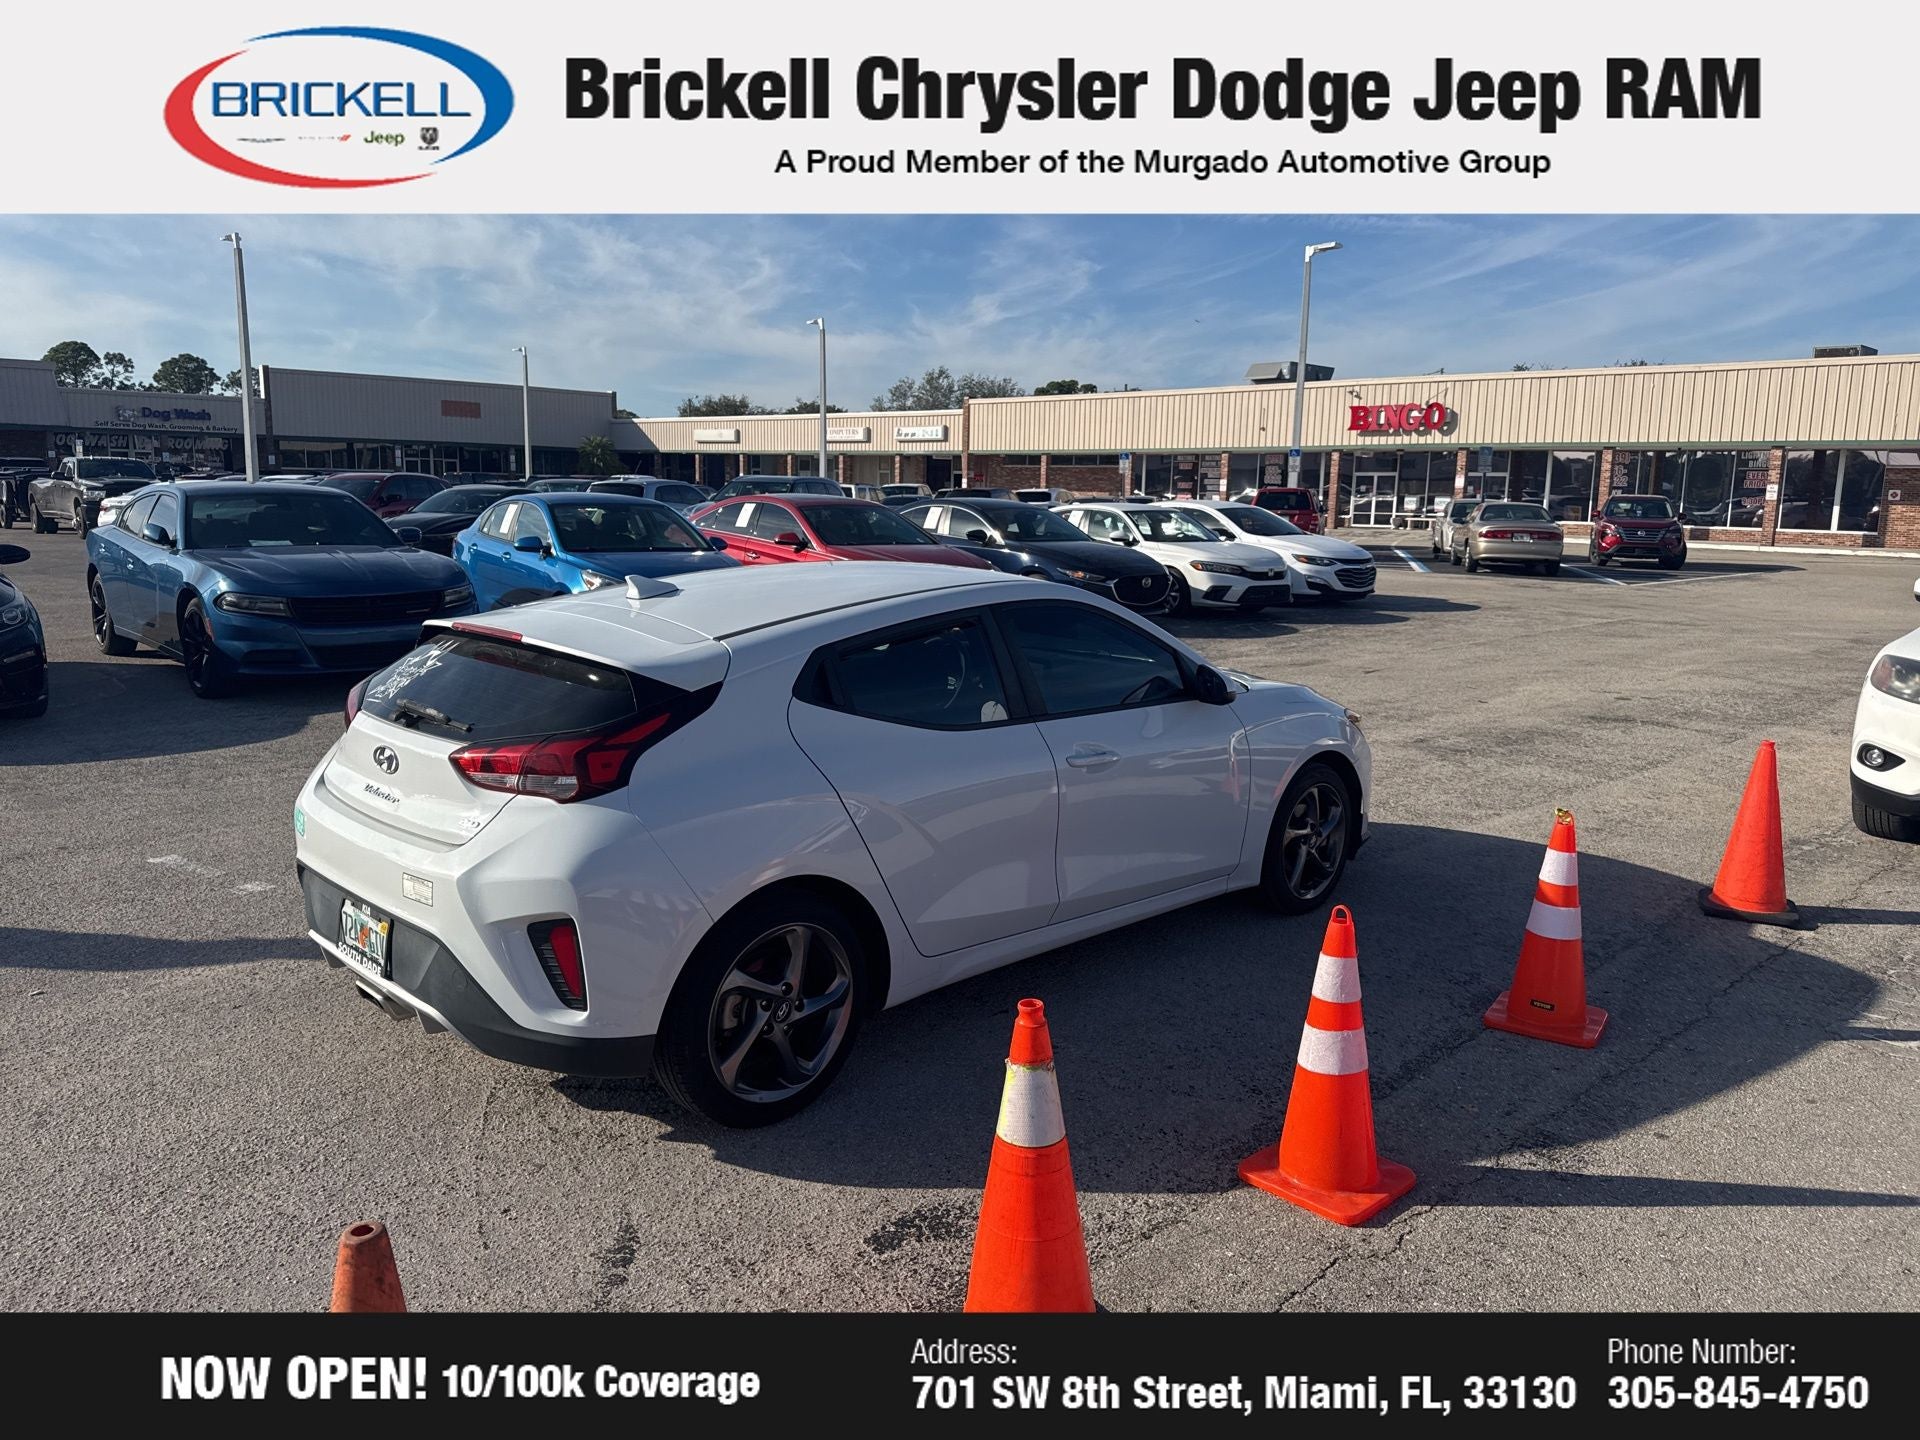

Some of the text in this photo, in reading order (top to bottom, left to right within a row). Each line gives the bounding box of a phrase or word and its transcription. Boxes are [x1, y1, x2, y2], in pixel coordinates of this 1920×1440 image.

[141, 407, 211, 421] Dog Wash
[1348, 402, 1445, 431] BINGO
[132, 422, 147, 430] Dog
[1743, 480, 1767, 488] FRIDA
[362, 904, 371, 917] KIA
[338, 942, 361, 963] SOUTH
[362, 957, 382, 976] DADE
